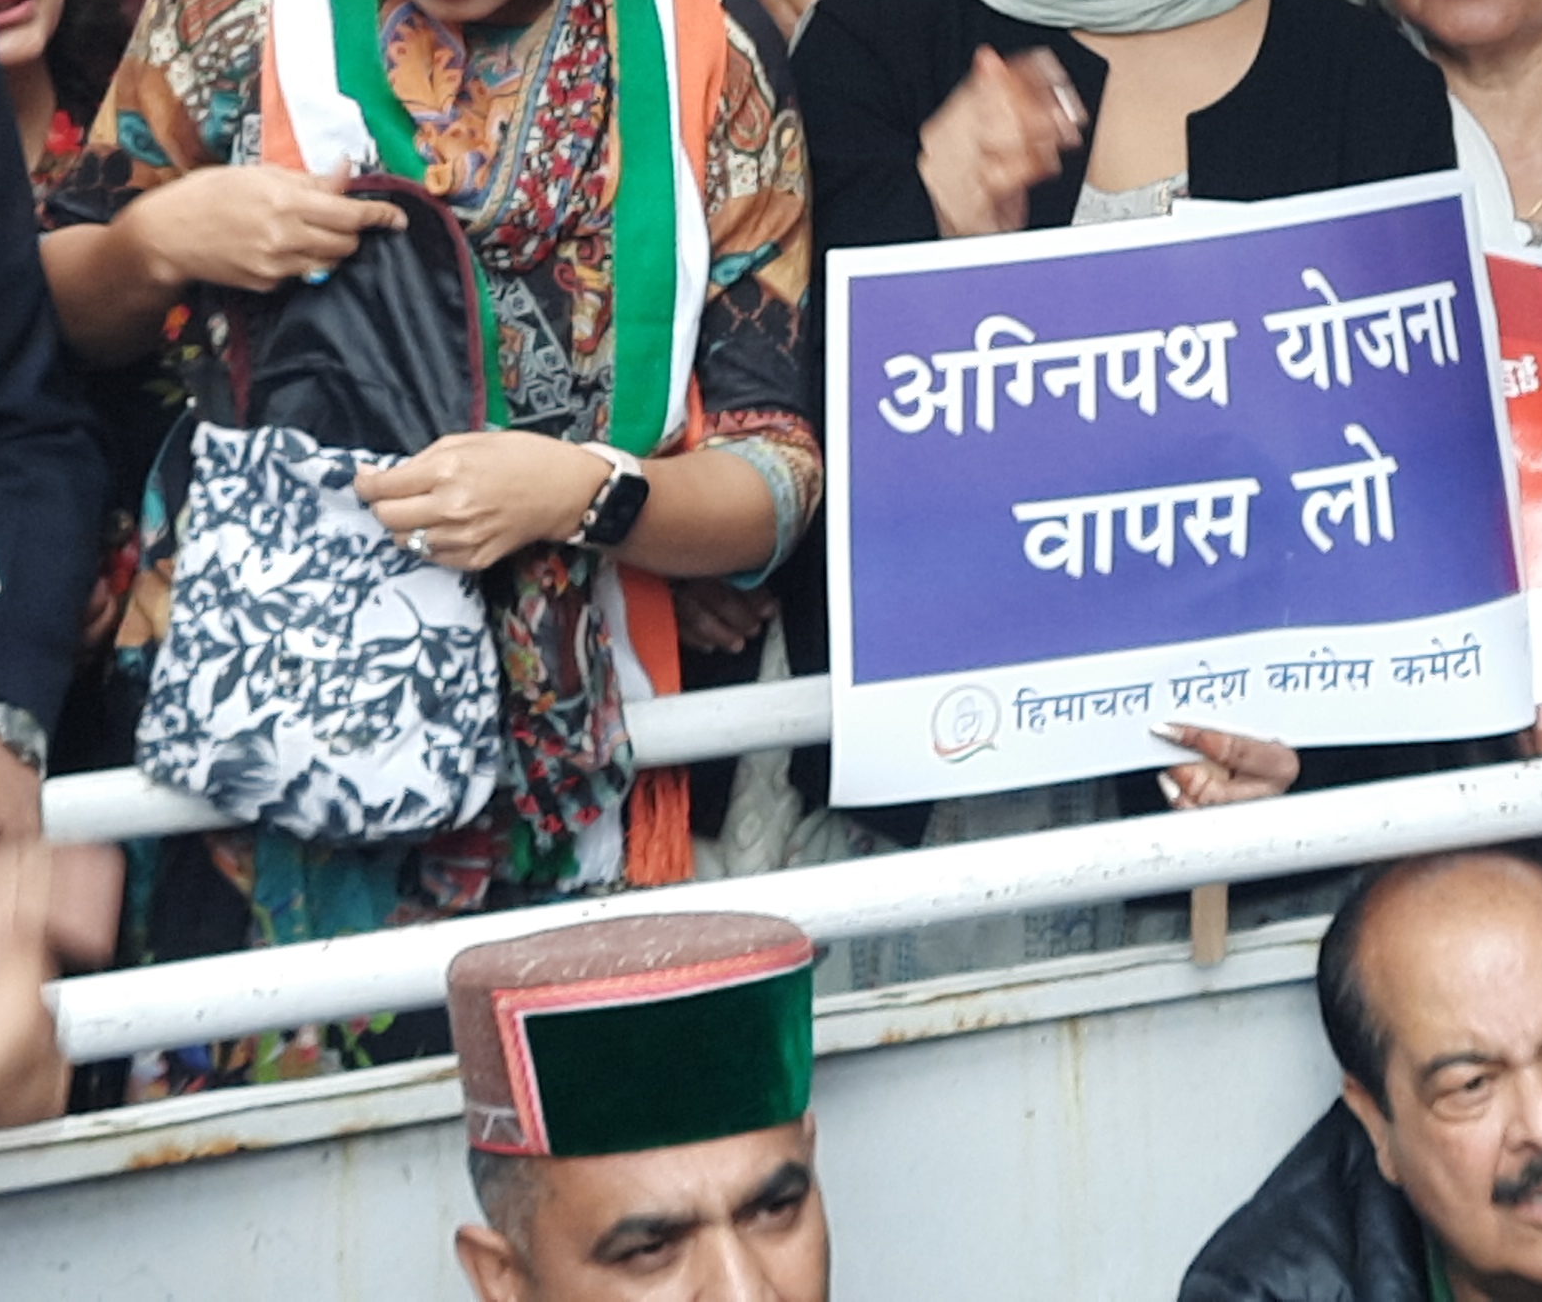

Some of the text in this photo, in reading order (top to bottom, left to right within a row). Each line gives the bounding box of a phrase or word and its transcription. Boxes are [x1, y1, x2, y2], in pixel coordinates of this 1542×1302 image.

[879, 268, 1459, 437] अग्निपथ योजना
[1013, 424, 1398, 579] वापस लो
[1013, 633, 1481, 732] हिमाचल प्रदेश कांग्रेस कमेटी
